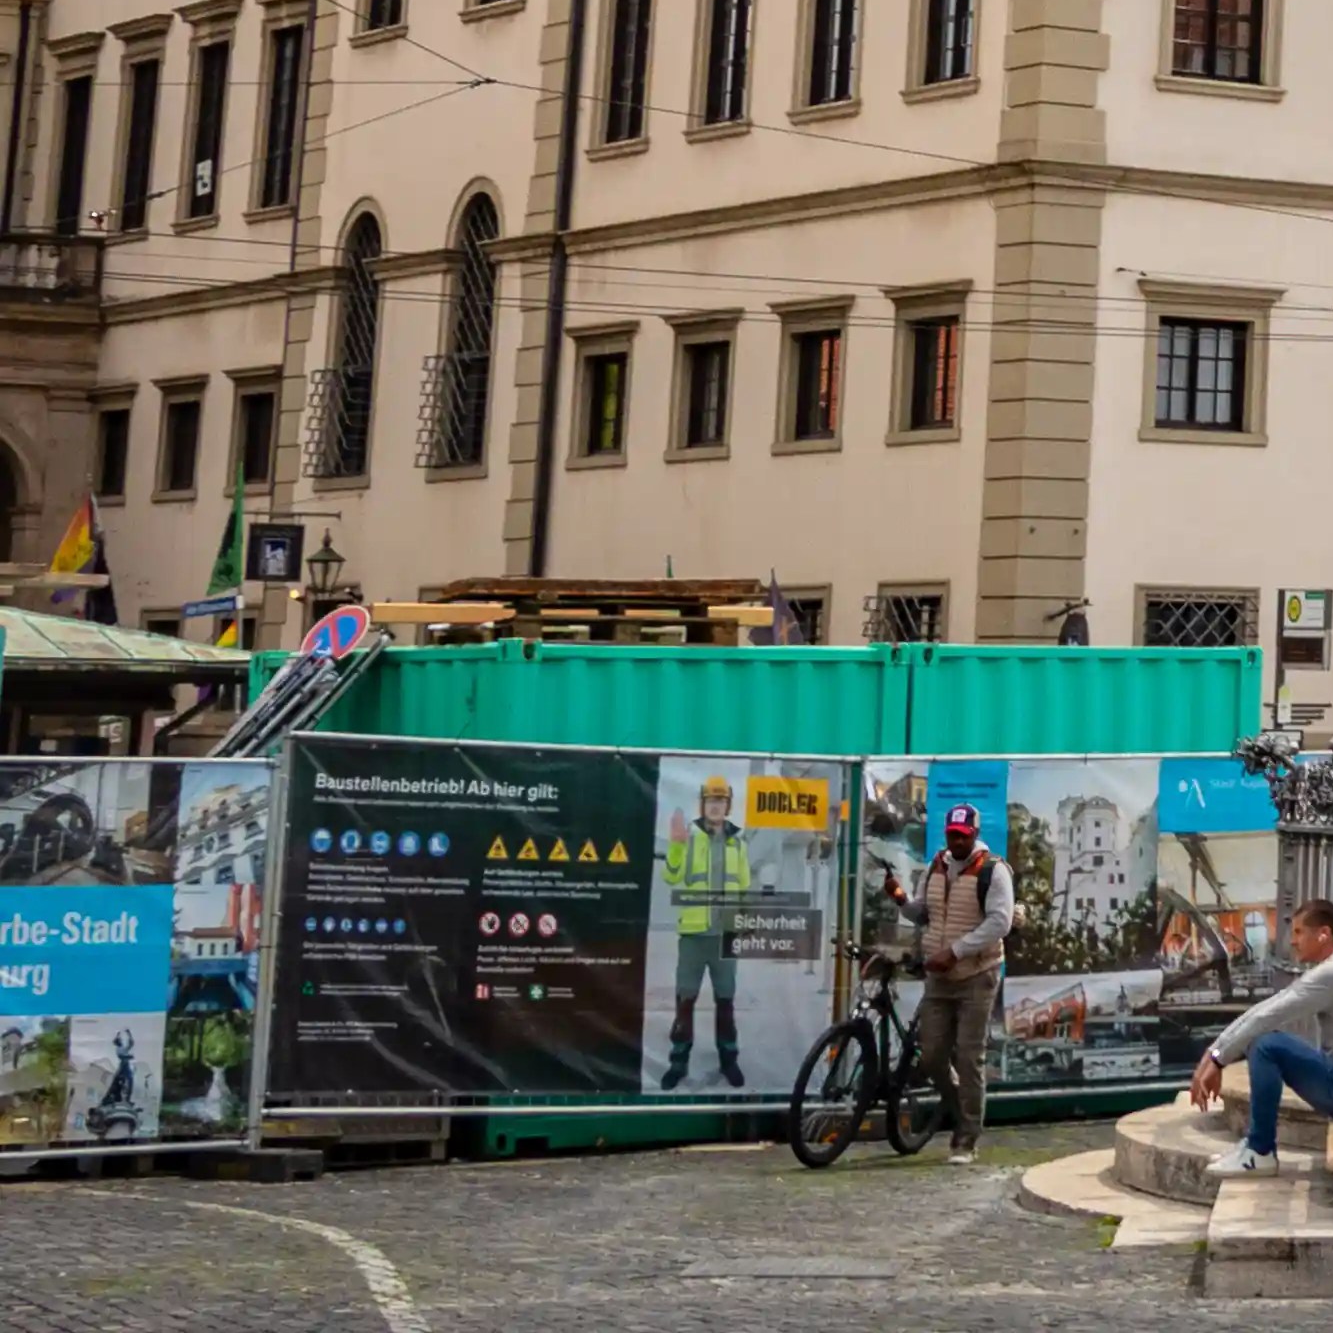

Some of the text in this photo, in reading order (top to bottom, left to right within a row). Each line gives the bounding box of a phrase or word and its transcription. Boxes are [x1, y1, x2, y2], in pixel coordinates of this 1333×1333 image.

[315, 772, 559, 802] Baustellenbetrieb! Ab hier gilt:
[734, 914, 807, 930] Sicherheit
[732, 935, 766, 953] geht
